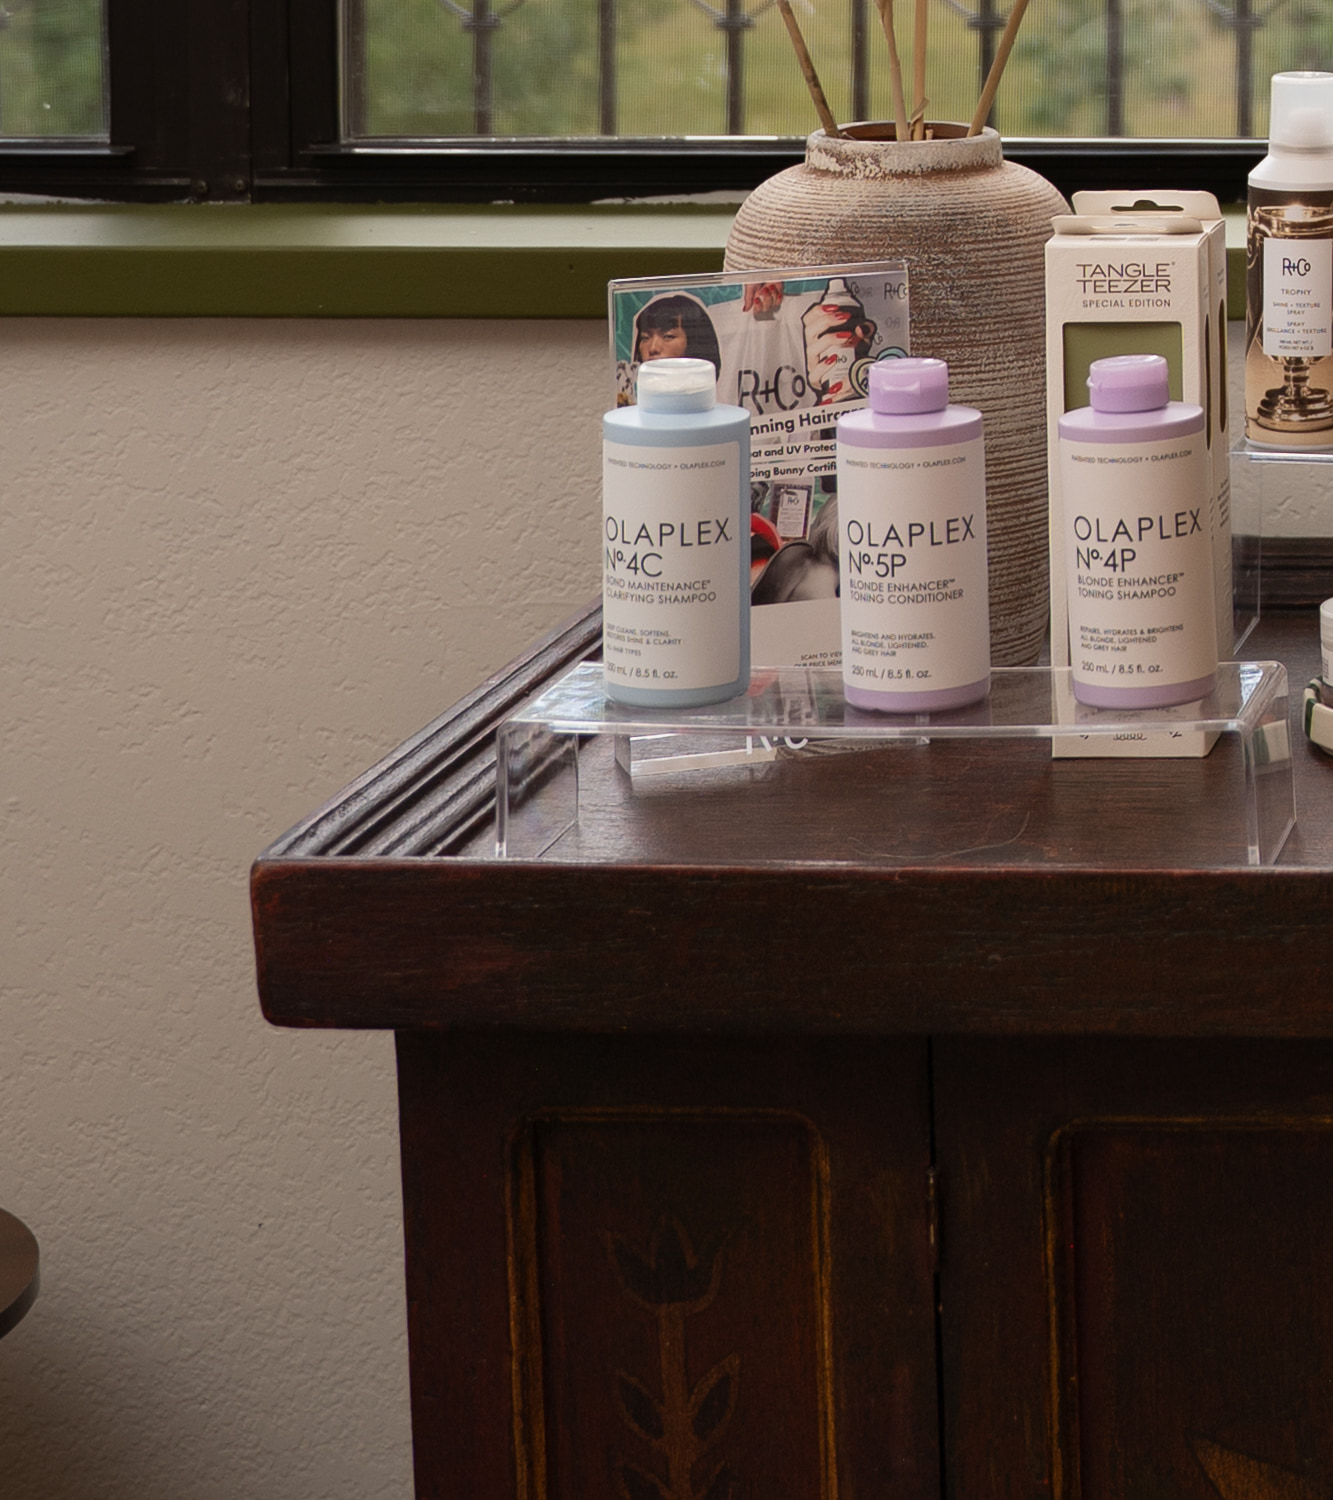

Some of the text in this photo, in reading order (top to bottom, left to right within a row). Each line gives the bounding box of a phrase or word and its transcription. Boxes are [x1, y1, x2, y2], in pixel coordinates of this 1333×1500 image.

[1282, 257, 1311, 277] R+Co
[1076, 279, 1171, 294] TEEZER
[1280, 288, 1312, 296] TROPHY
[1082, 299, 1171, 308] SPECIAL EDITION
[764, 447, 784, 457] and
[787, 445, 802, 455] UV
[773, 466, 804, 478] Bunny
[807, 463, 837, 474] Certifi
[847, 514, 976, 548] OLAPLEX
[1074, 507, 1202, 542] OLAPLEX
[850, 577, 884, 593] BLONDE
[1078, 573, 1114, 587] BLONDE
[606, 589, 716, 604] CLARIFYING SHAMPOO
[850, 589, 964, 605] TONING CONDITIONER
[1078, 586, 1176, 600] TONING SHAMPOO
[653, 637, 682, 646] CLARITY
[800, 652, 827, 661] SCAN TO
[636, 666, 650, 679] 8.5
[652, 666, 661, 679] fl.
[663, 670, 679, 679] oz.
[852, 664, 865, 677] 250
[887, 668, 903, 679] 8.5
[906, 666, 914, 679] fl.
[916, 670, 932, 679] oz.
[1118, 663, 1134, 674] 8.5
[1136, 662, 1145, 673] fl.
[1148, 665, 1164, 673] oz.
